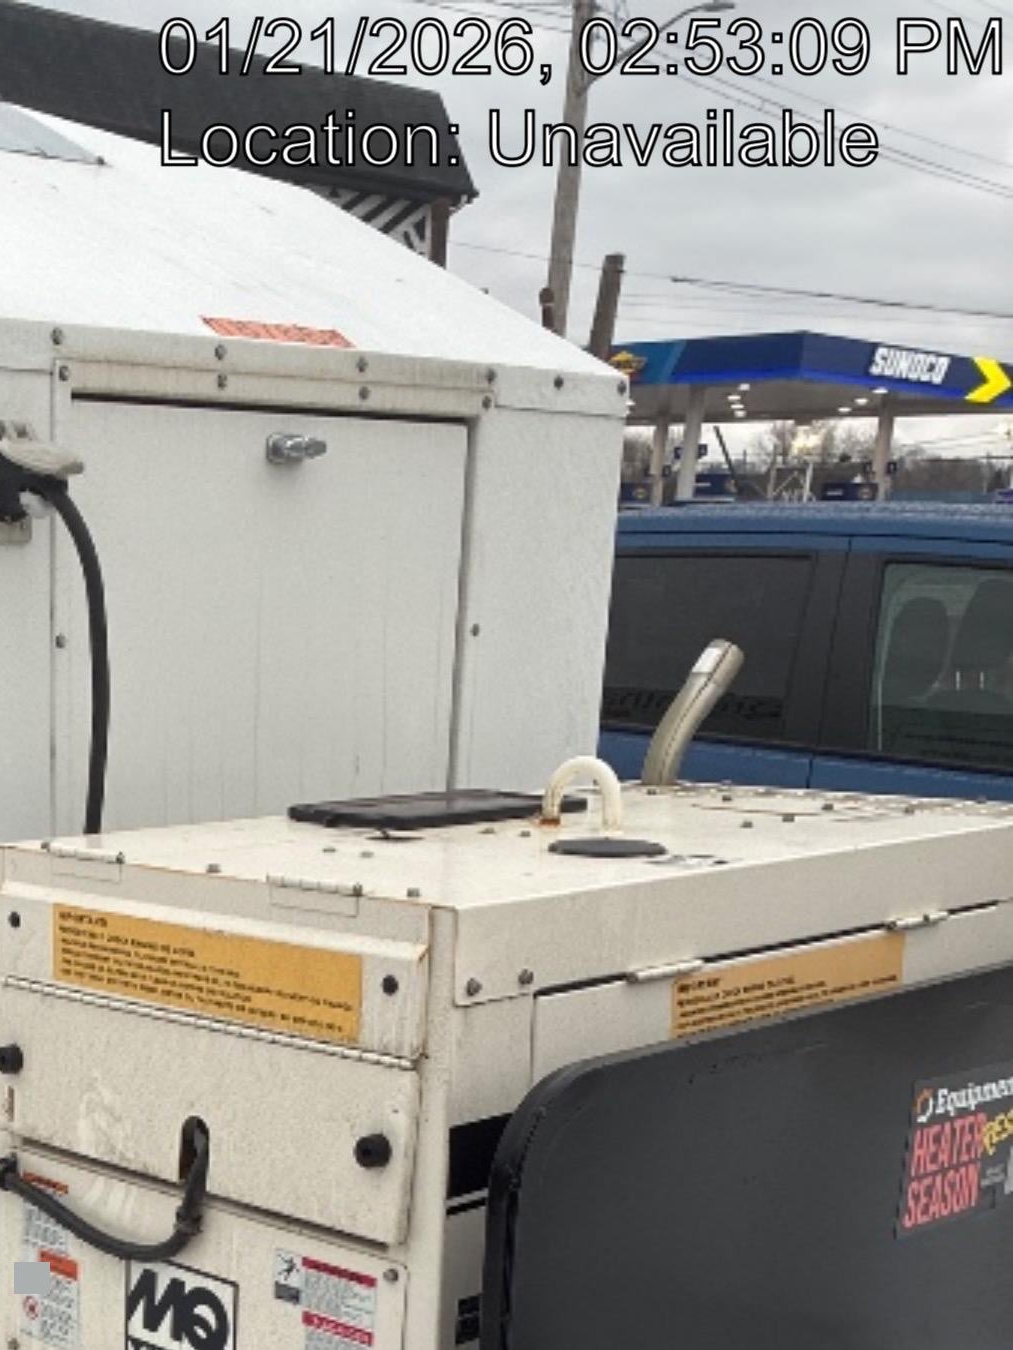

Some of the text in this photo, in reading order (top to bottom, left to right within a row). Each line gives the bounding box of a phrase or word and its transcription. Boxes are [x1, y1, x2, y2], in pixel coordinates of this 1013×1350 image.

[869, 347, 951, 385] SUNOCO
[911, 1112, 987, 1177] HEATER
[904, 1161, 980, 1228] SEASON
